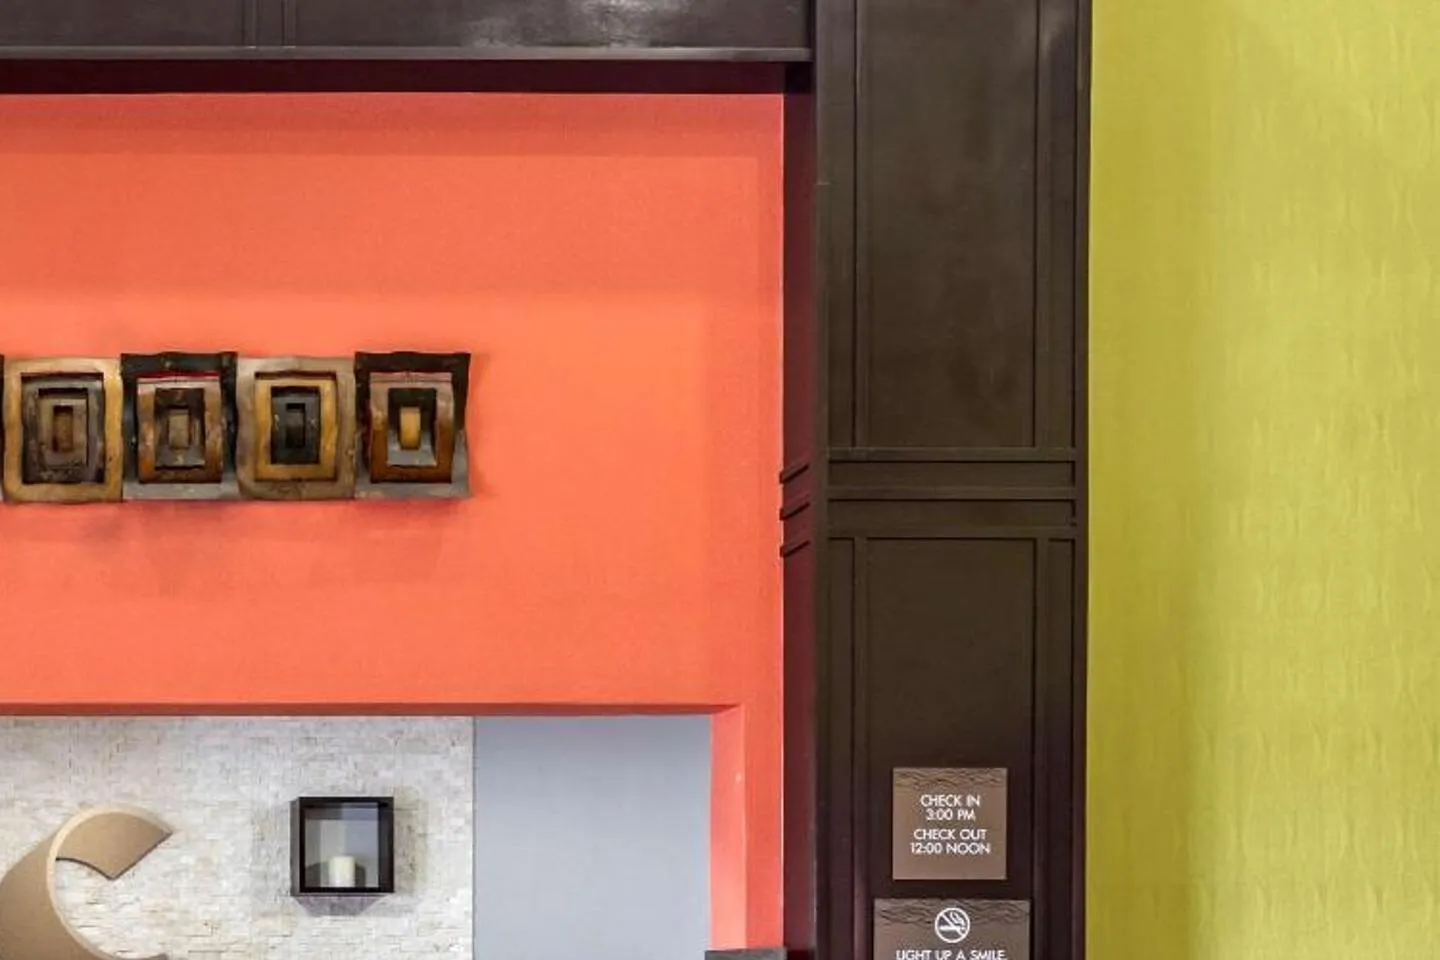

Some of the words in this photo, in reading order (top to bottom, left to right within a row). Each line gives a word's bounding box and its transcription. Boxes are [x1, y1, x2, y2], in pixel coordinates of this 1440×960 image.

[920, 794, 962, 807] CHECK
[966, 794, 981, 807] IN
[926, 808, 953, 821] 3:00
[957, 808, 976, 821] PM
[913, 828, 956, 840] CHECK
[960, 828, 987, 840] OUT
[910, 842, 942, 854] 12:00
[946, 842, 991, 854] NOON
[896, 950, 932, 960] LIGHT
[935, 950, 952, 960] UP
[956, 950, 966, 960] A
